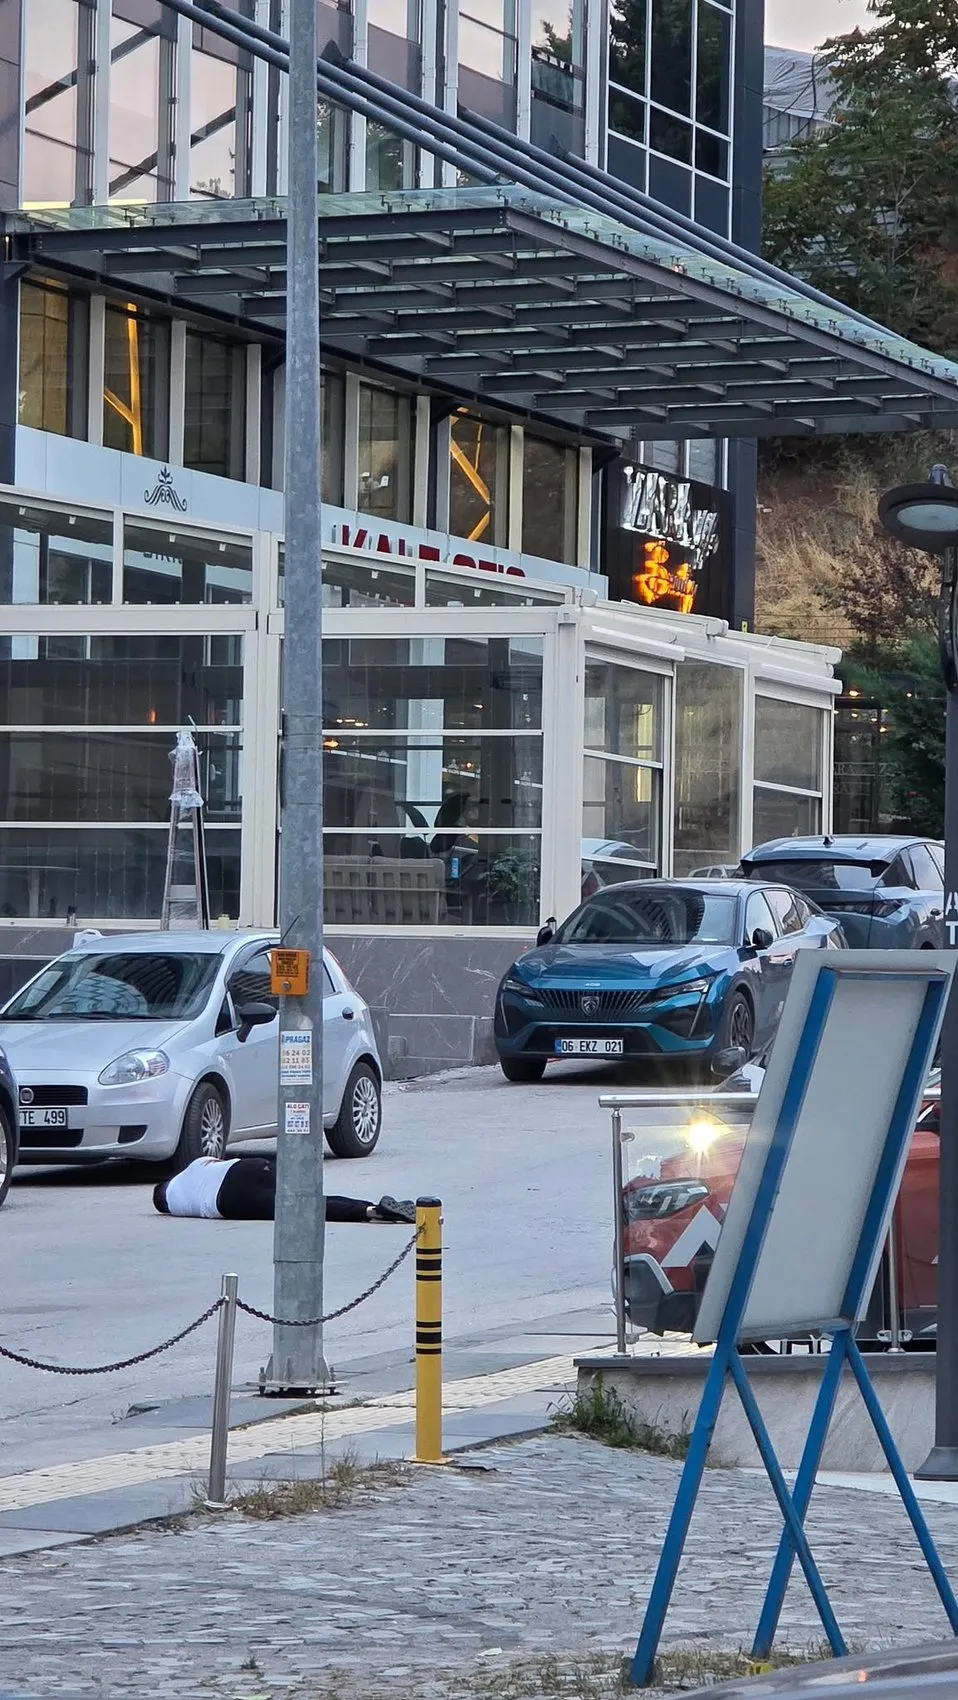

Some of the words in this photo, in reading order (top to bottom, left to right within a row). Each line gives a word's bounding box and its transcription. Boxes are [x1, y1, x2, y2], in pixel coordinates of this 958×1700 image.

[562, 1041, 574, 1052] 06
[580, 1041, 597, 1052] EKZ
[605, 1041, 622, 1052] 021
[19, 1111, 35, 1124] TE
[44, 1111, 65, 1124] 499
